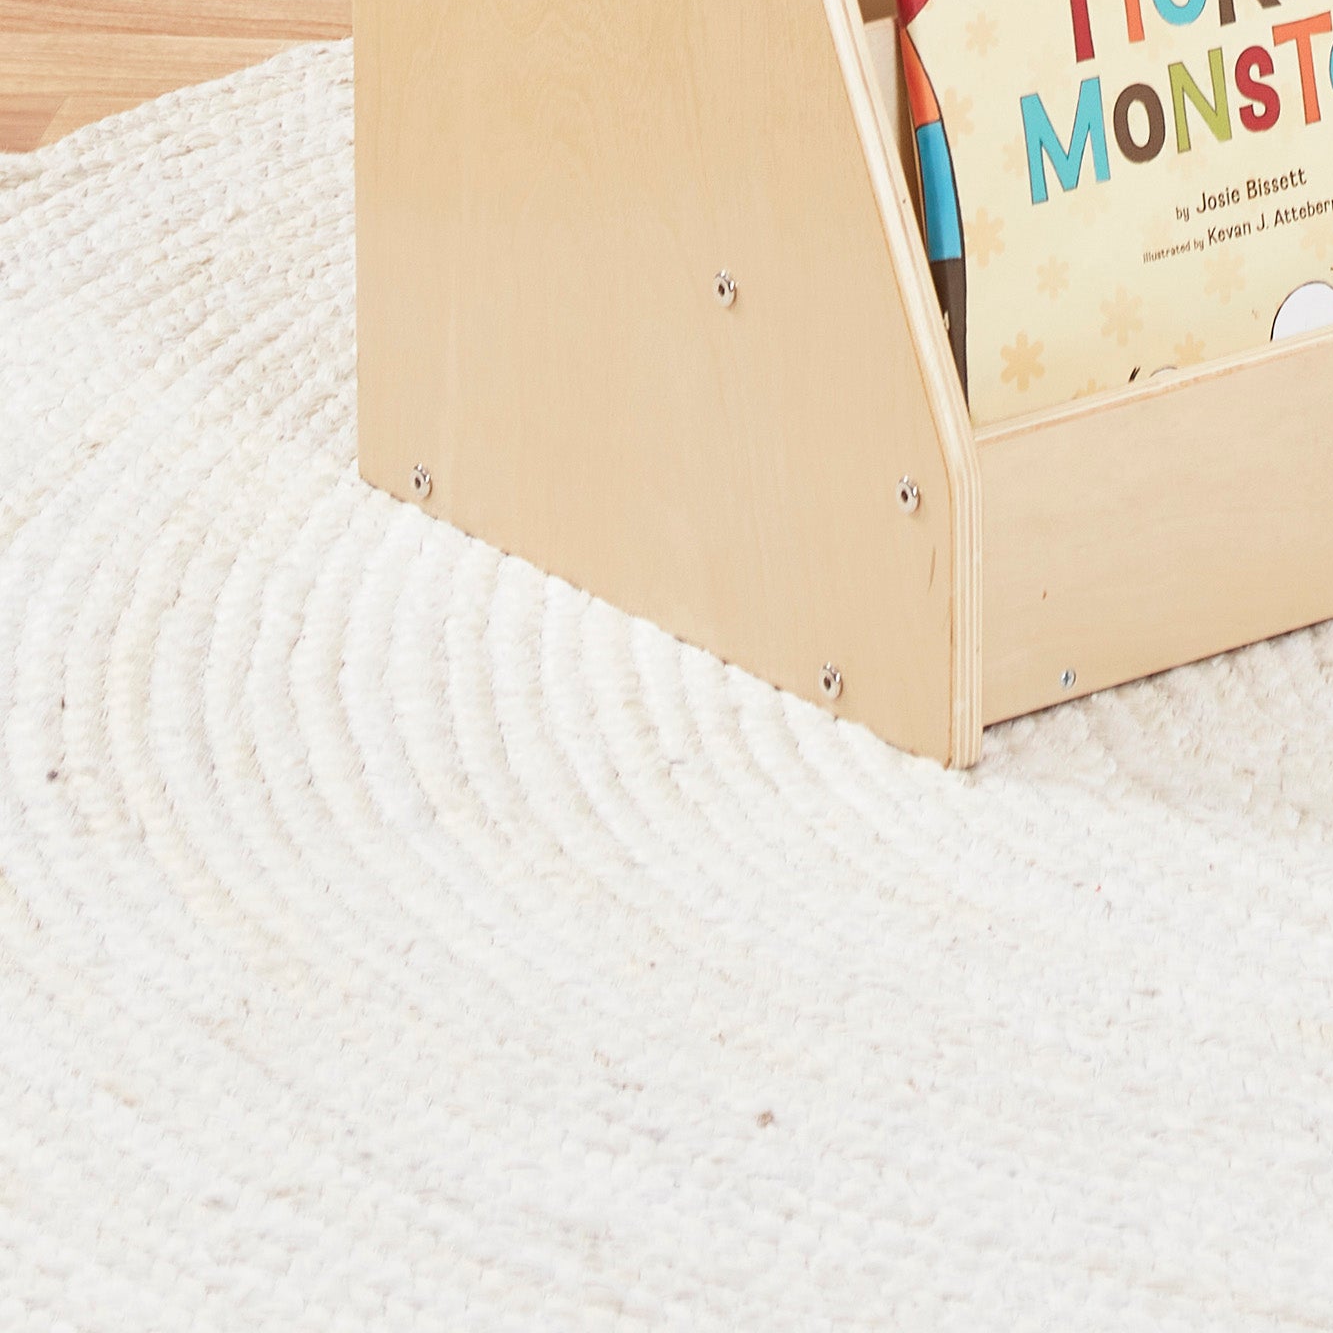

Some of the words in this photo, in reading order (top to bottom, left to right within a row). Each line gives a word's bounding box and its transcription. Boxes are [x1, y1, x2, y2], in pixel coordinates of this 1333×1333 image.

[1175, 206, 1190, 222] by
[1196, 187, 1241, 214] Josie
[1246, 168, 1308, 200] Bissett
[1143, 240, 1191, 264] illustrated
[1194, 237, 1206, 252] by
[1207, 221, 1252, 246] Kevan
[1256, 213, 1269, 232] J.
